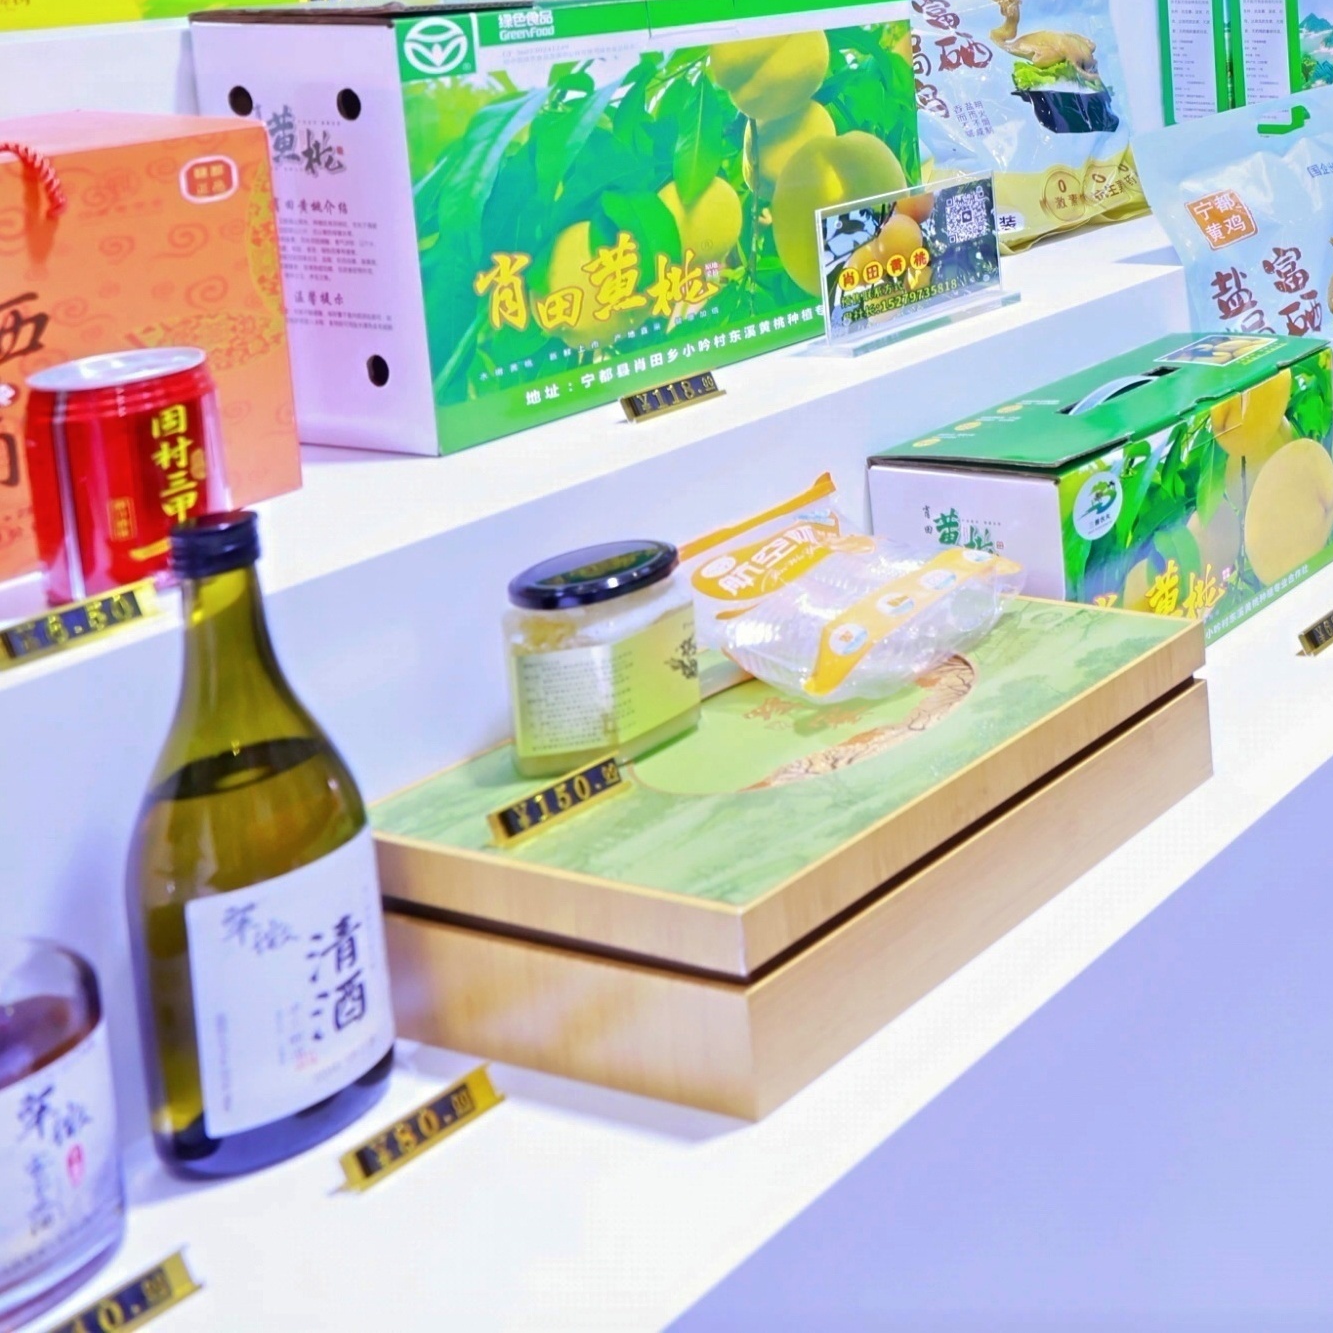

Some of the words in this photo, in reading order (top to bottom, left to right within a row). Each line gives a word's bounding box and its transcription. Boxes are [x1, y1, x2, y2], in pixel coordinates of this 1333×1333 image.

[499, 10, 553, 28] 绿色食品
[998, 215, 1017, 231] 装
[1193, 195, 1235, 220] 宁都
[1205, 214, 1247, 242] 黄鸡
[475, 231, 722, 331] 肖田黄桃
[841, 249, 929, 289] 肖田黄桃
[1262, 246, 1323, 336] 富硒
[635, 375, 716, 413] ¥118.00
[509, 760, 620, 829] ¥150.00
[306, 914, 366, 1040] 清酒
